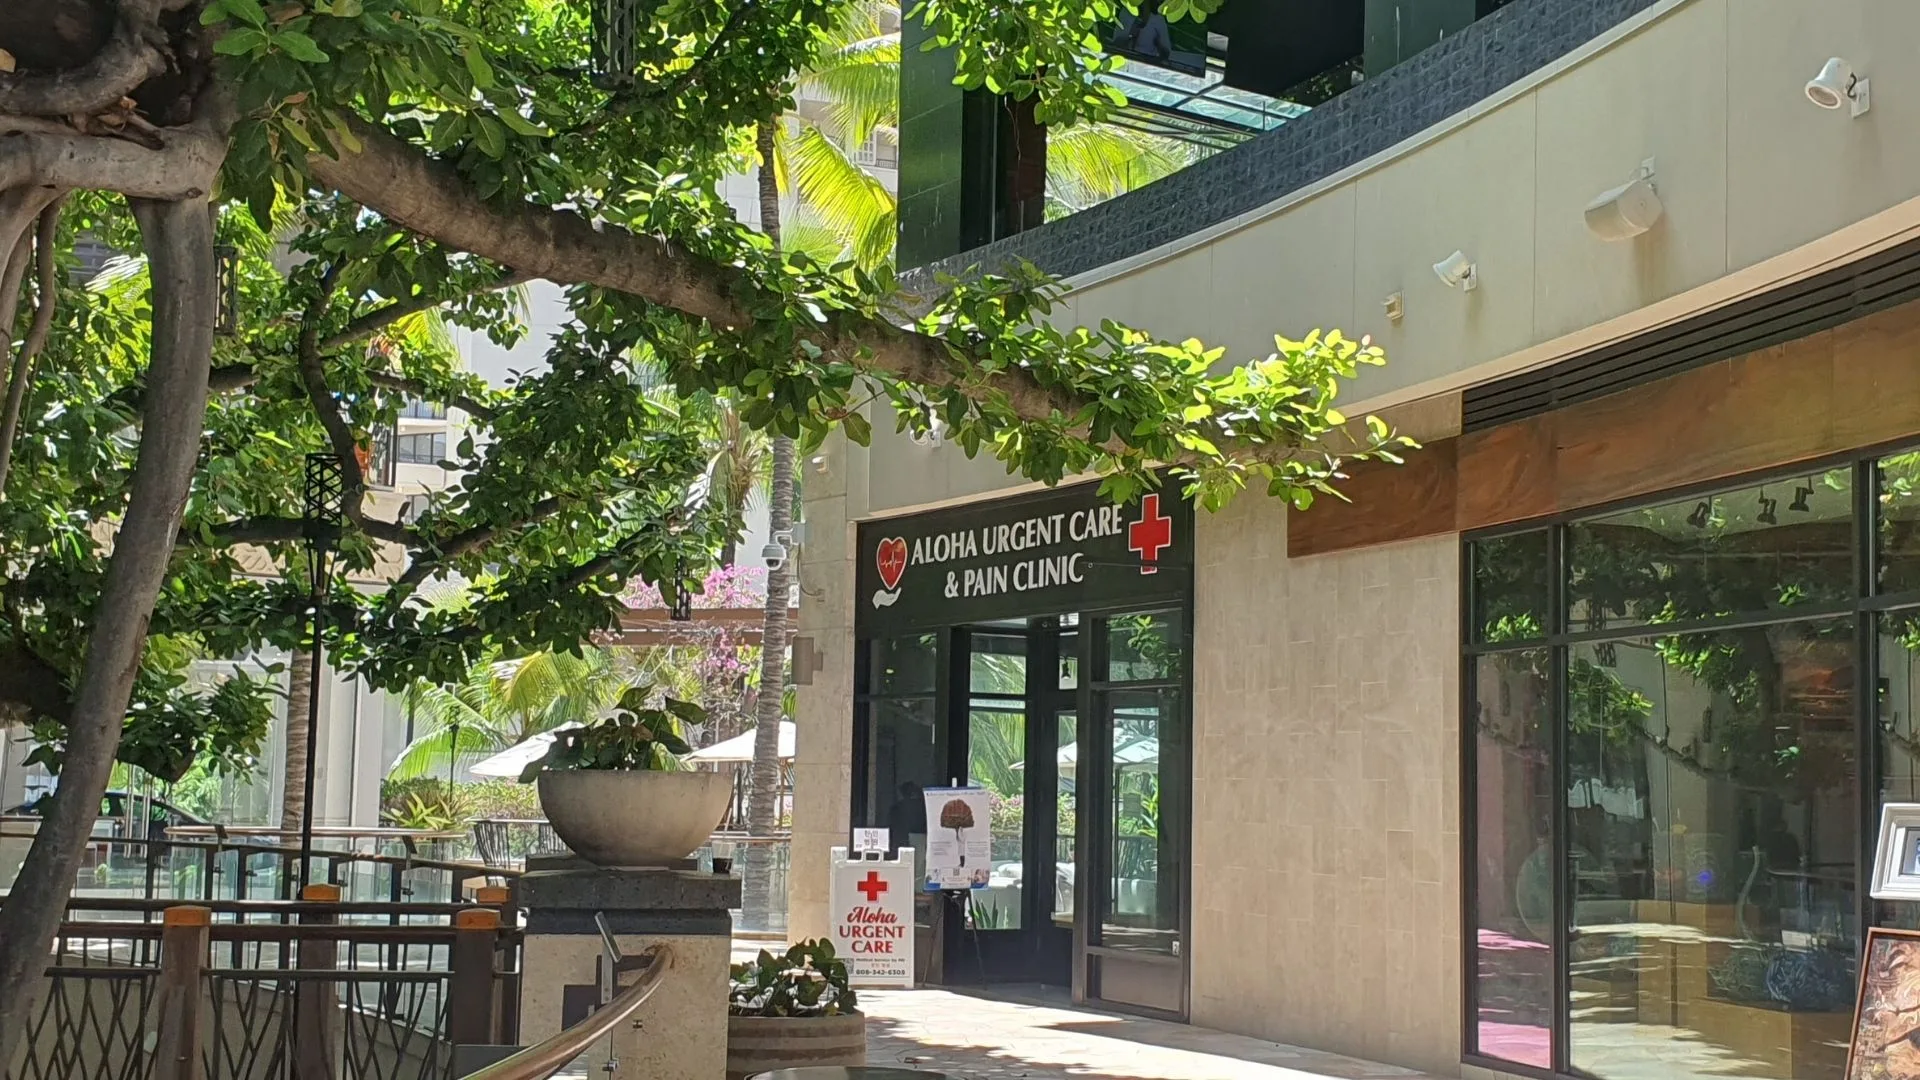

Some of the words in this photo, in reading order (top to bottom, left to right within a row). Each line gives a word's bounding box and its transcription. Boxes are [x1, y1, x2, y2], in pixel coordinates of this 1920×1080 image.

[910, 529, 978, 566] ALOHA
[982, 513, 1065, 555] URGENT
[1069, 503, 1123, 541] CARE
[944, 570, 959, 598] &
[963, 564, 1008, 597] PAIN
[1012, 552, 1084, 592] CLINIC
[847, 906, 898, 924] Aloha
[839, 925, 905, 938] URGENT
[851, 940, 893, 954] CARE
